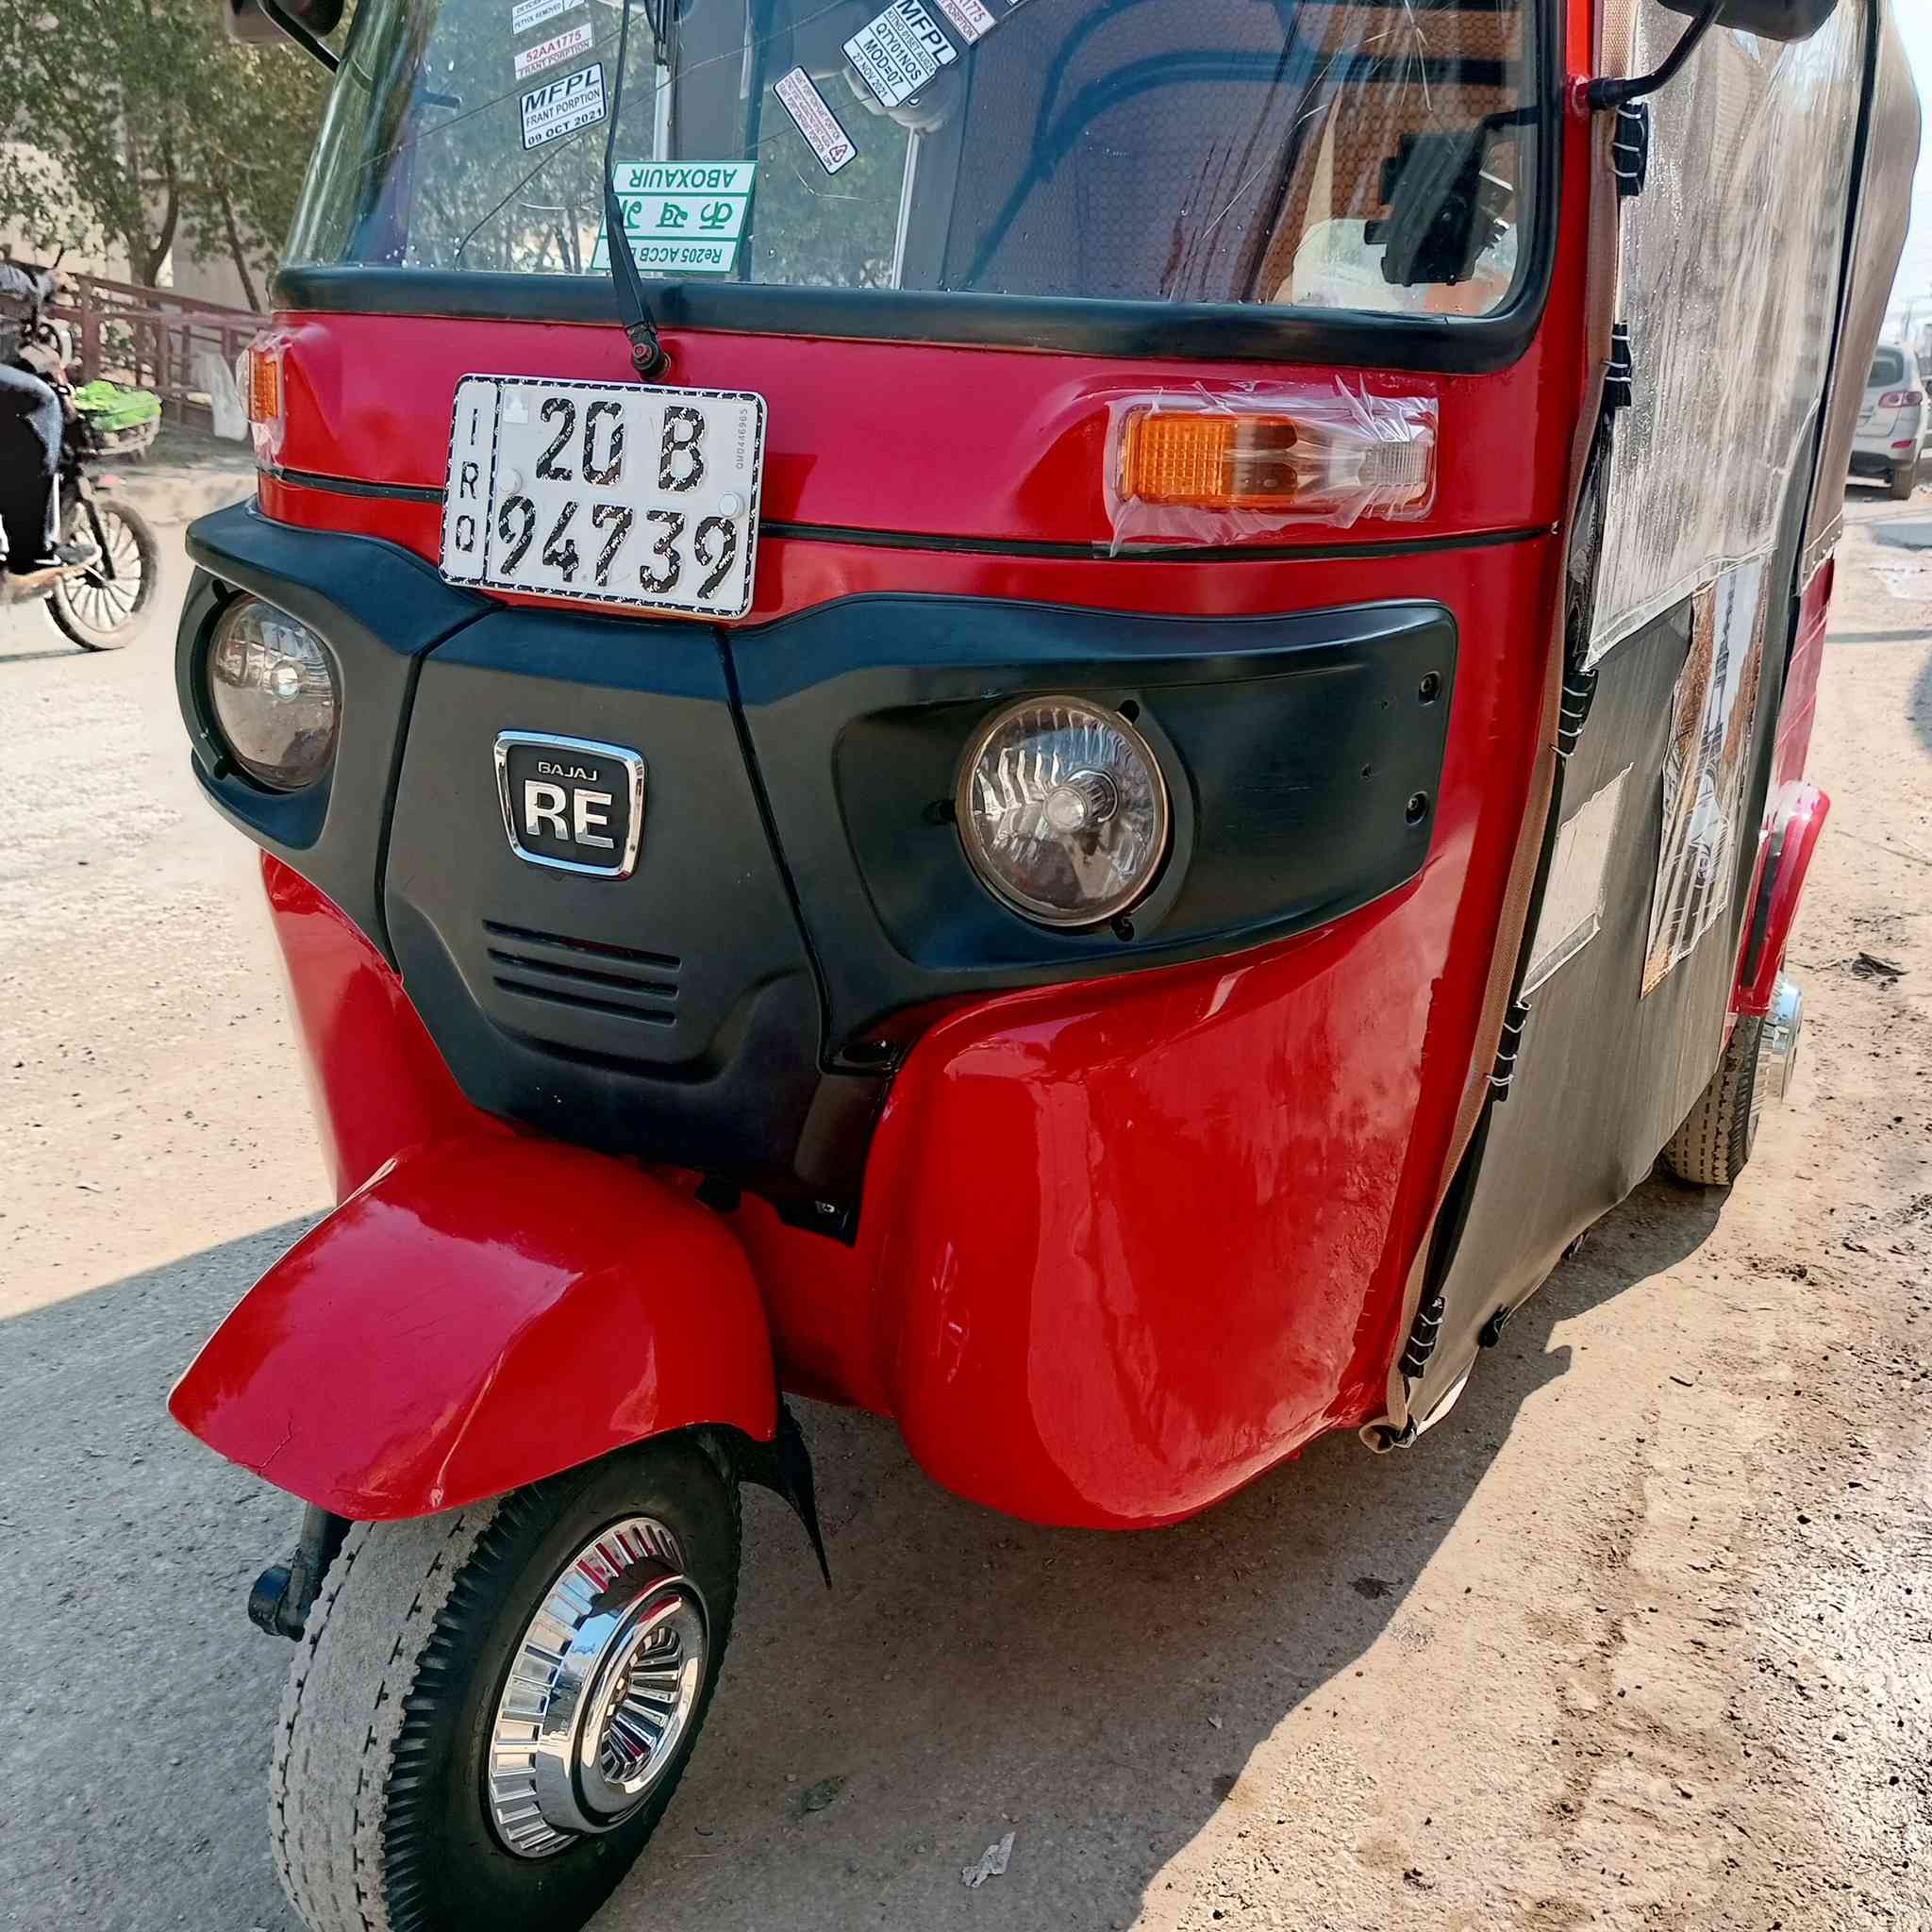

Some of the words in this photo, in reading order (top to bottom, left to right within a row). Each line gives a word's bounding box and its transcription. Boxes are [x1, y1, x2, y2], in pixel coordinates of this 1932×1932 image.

[875, 23, 922, 80] QTY01NOS
[897, 0, 949, 64] MFPL
[863, 39, 904, 87] MOD=07
[525, 69, 600, 114] MFPL
[525, 108, 554, 127] FRANT
[556, 88, 601, 113] PORPTION
[545, 123, 570, 138] OCT
[574, 108, 602, 125] 2021
[639, 247, 680, 263] ACCB
[680, 247, 723, 264] Re205
[536, 397, 625, 486] 20
[658, 406, 707, 492] B
[497, 495, 738, 600] 94739
[538, 761, 597, 781] BAJAJ
[525, 779, 615, 850] RE
